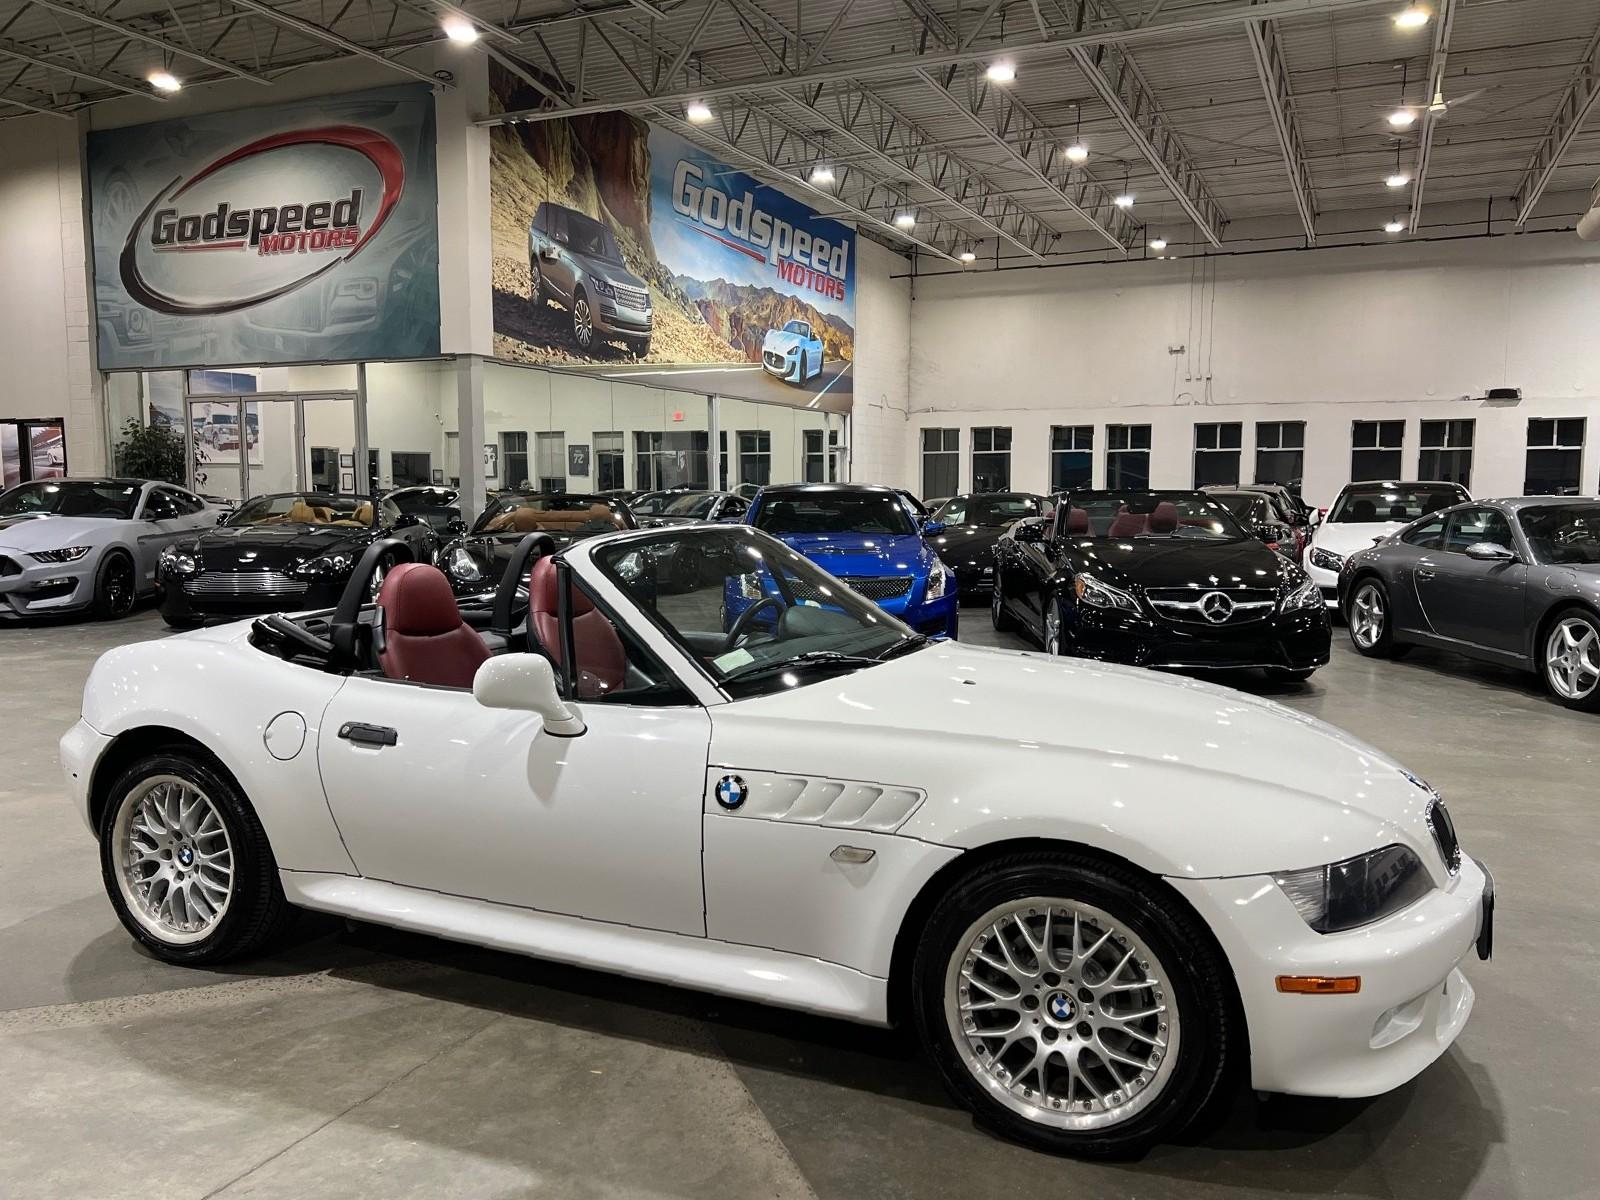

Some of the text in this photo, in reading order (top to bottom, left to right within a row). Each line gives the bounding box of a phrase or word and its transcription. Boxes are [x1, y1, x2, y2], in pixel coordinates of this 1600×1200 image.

[151, 188, 364, 247] Godspeed
[672, 159, 848, 279] Godspeed
[259, 228, 361, 255] MOTORS
[776, 257, 846, 301] MOTORS
[574, 453, 584, 463] 72
